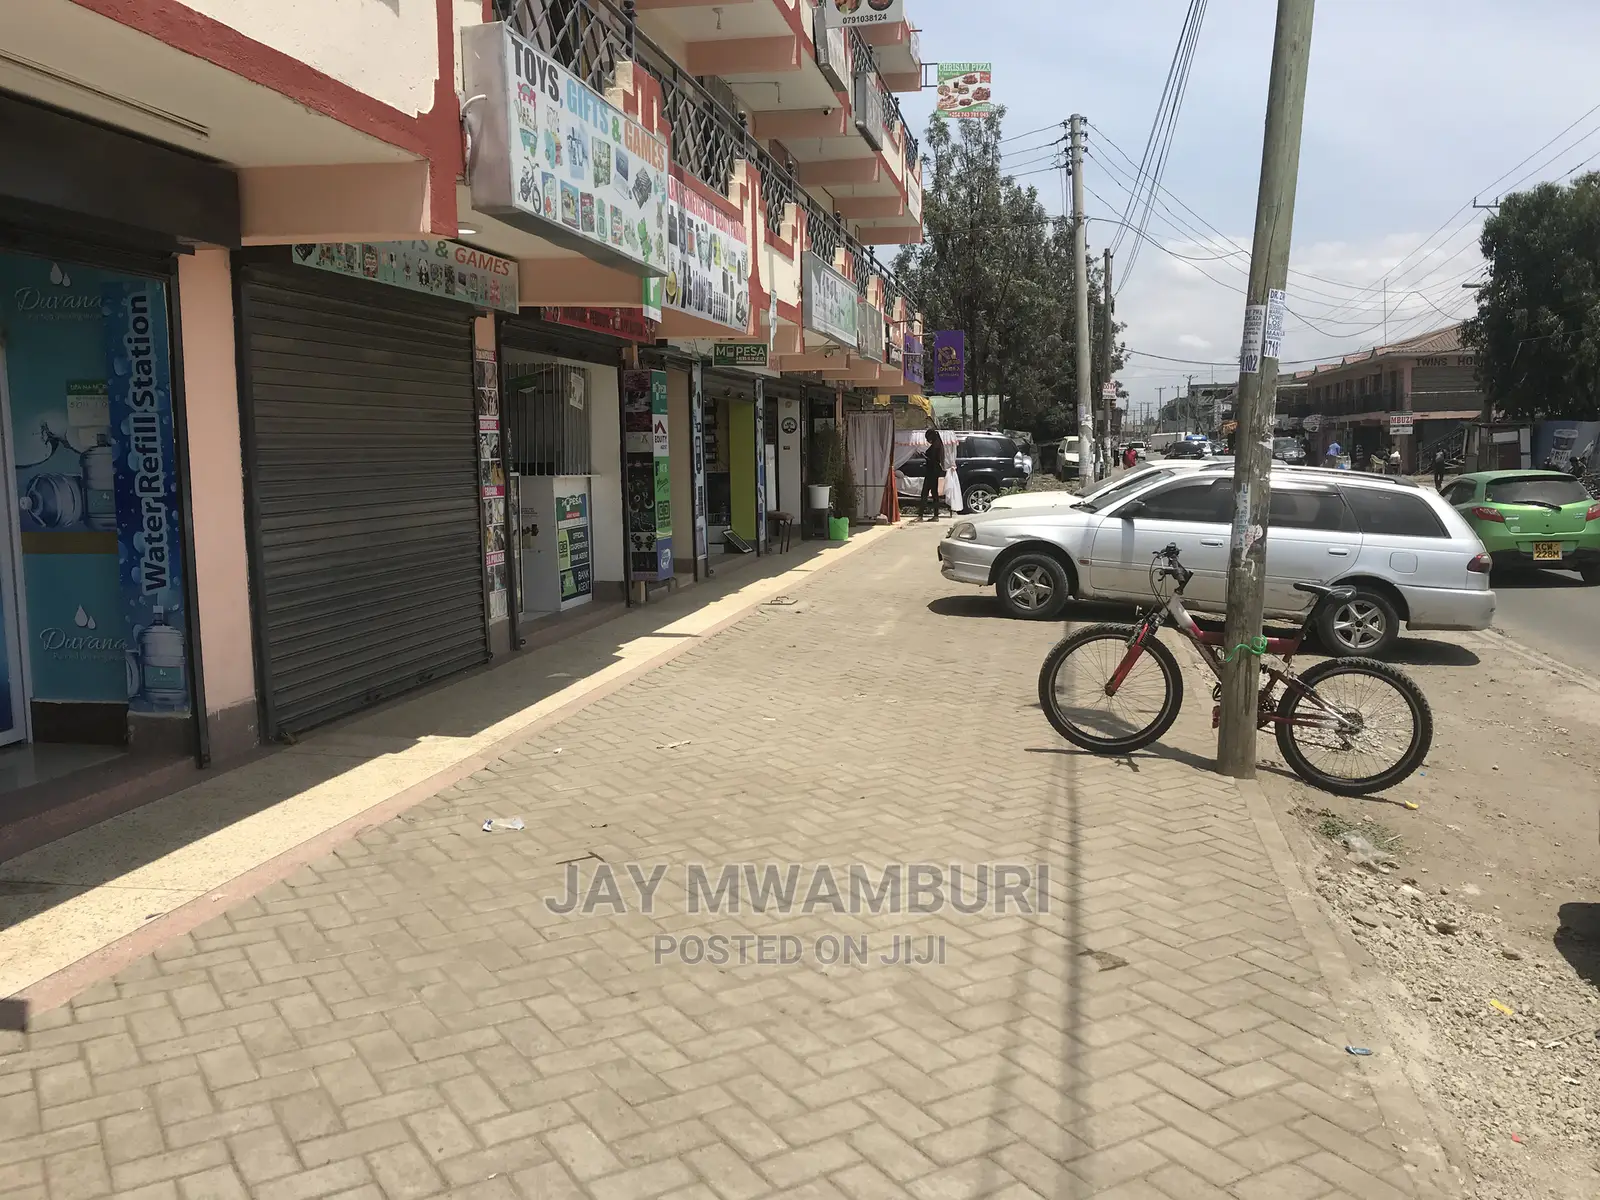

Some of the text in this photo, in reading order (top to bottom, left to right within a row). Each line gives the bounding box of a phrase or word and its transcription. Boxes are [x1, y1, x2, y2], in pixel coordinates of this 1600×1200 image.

[842, 13, 887, 25] 0791038124
[938, 63, 991, 72] CHRISAM PIZZA
[566, 79, 609, 136] GIFTS
[611, 115, 622, 145] &
[624, 119, 665, 173] GAMES
[435, 240, 449, 259] &
[455, 247, 510, 276] GAMES
[1415, 357, 1448, 367] TWINS
[1390, 416, 1413, 425] MBUZI
[127, 294, 168, 593] Water Refill Station
[1535, 543, 1553, 551] KCW
[1536, 550, 1560, 558] 228M
